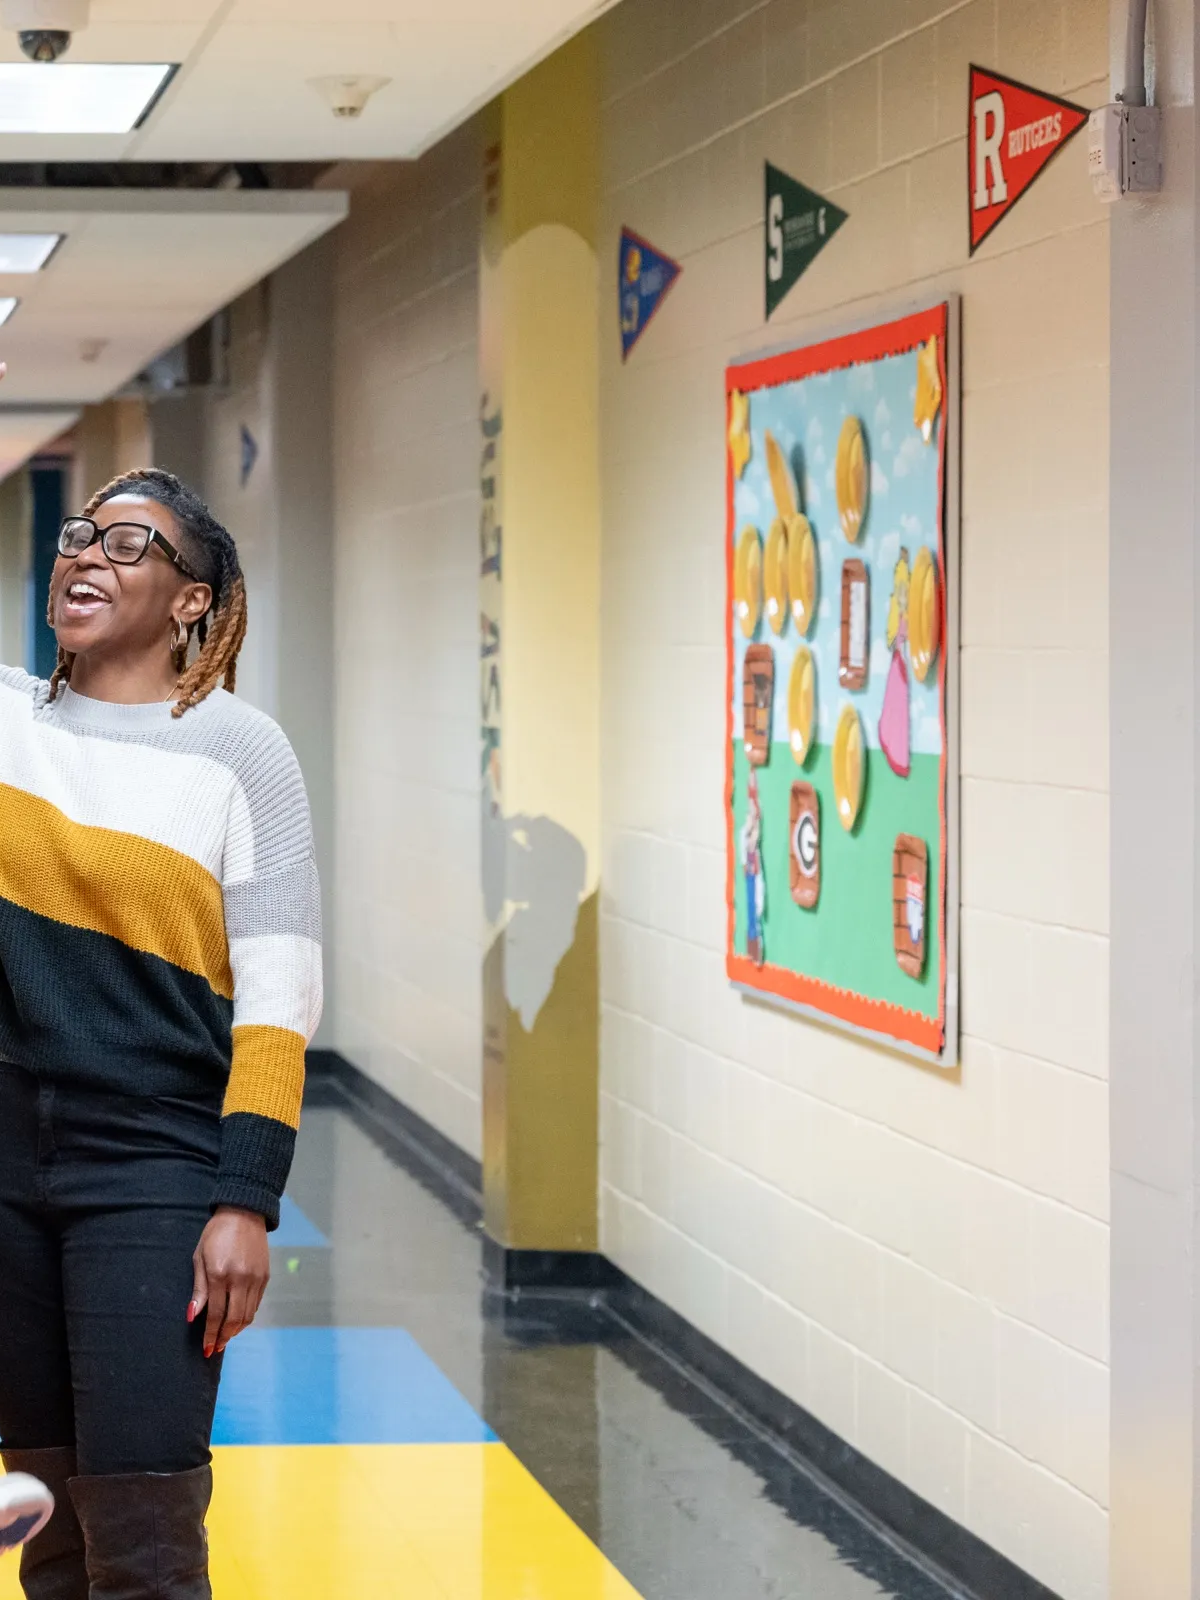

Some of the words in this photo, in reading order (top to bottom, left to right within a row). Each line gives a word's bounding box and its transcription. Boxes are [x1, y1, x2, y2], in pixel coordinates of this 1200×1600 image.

[974, 91, 1007, 210] R
[1008, 112, 1062, 159] RUTGERS
[768, 194, 784, 282] S
[797, 815, 817, 870] G
